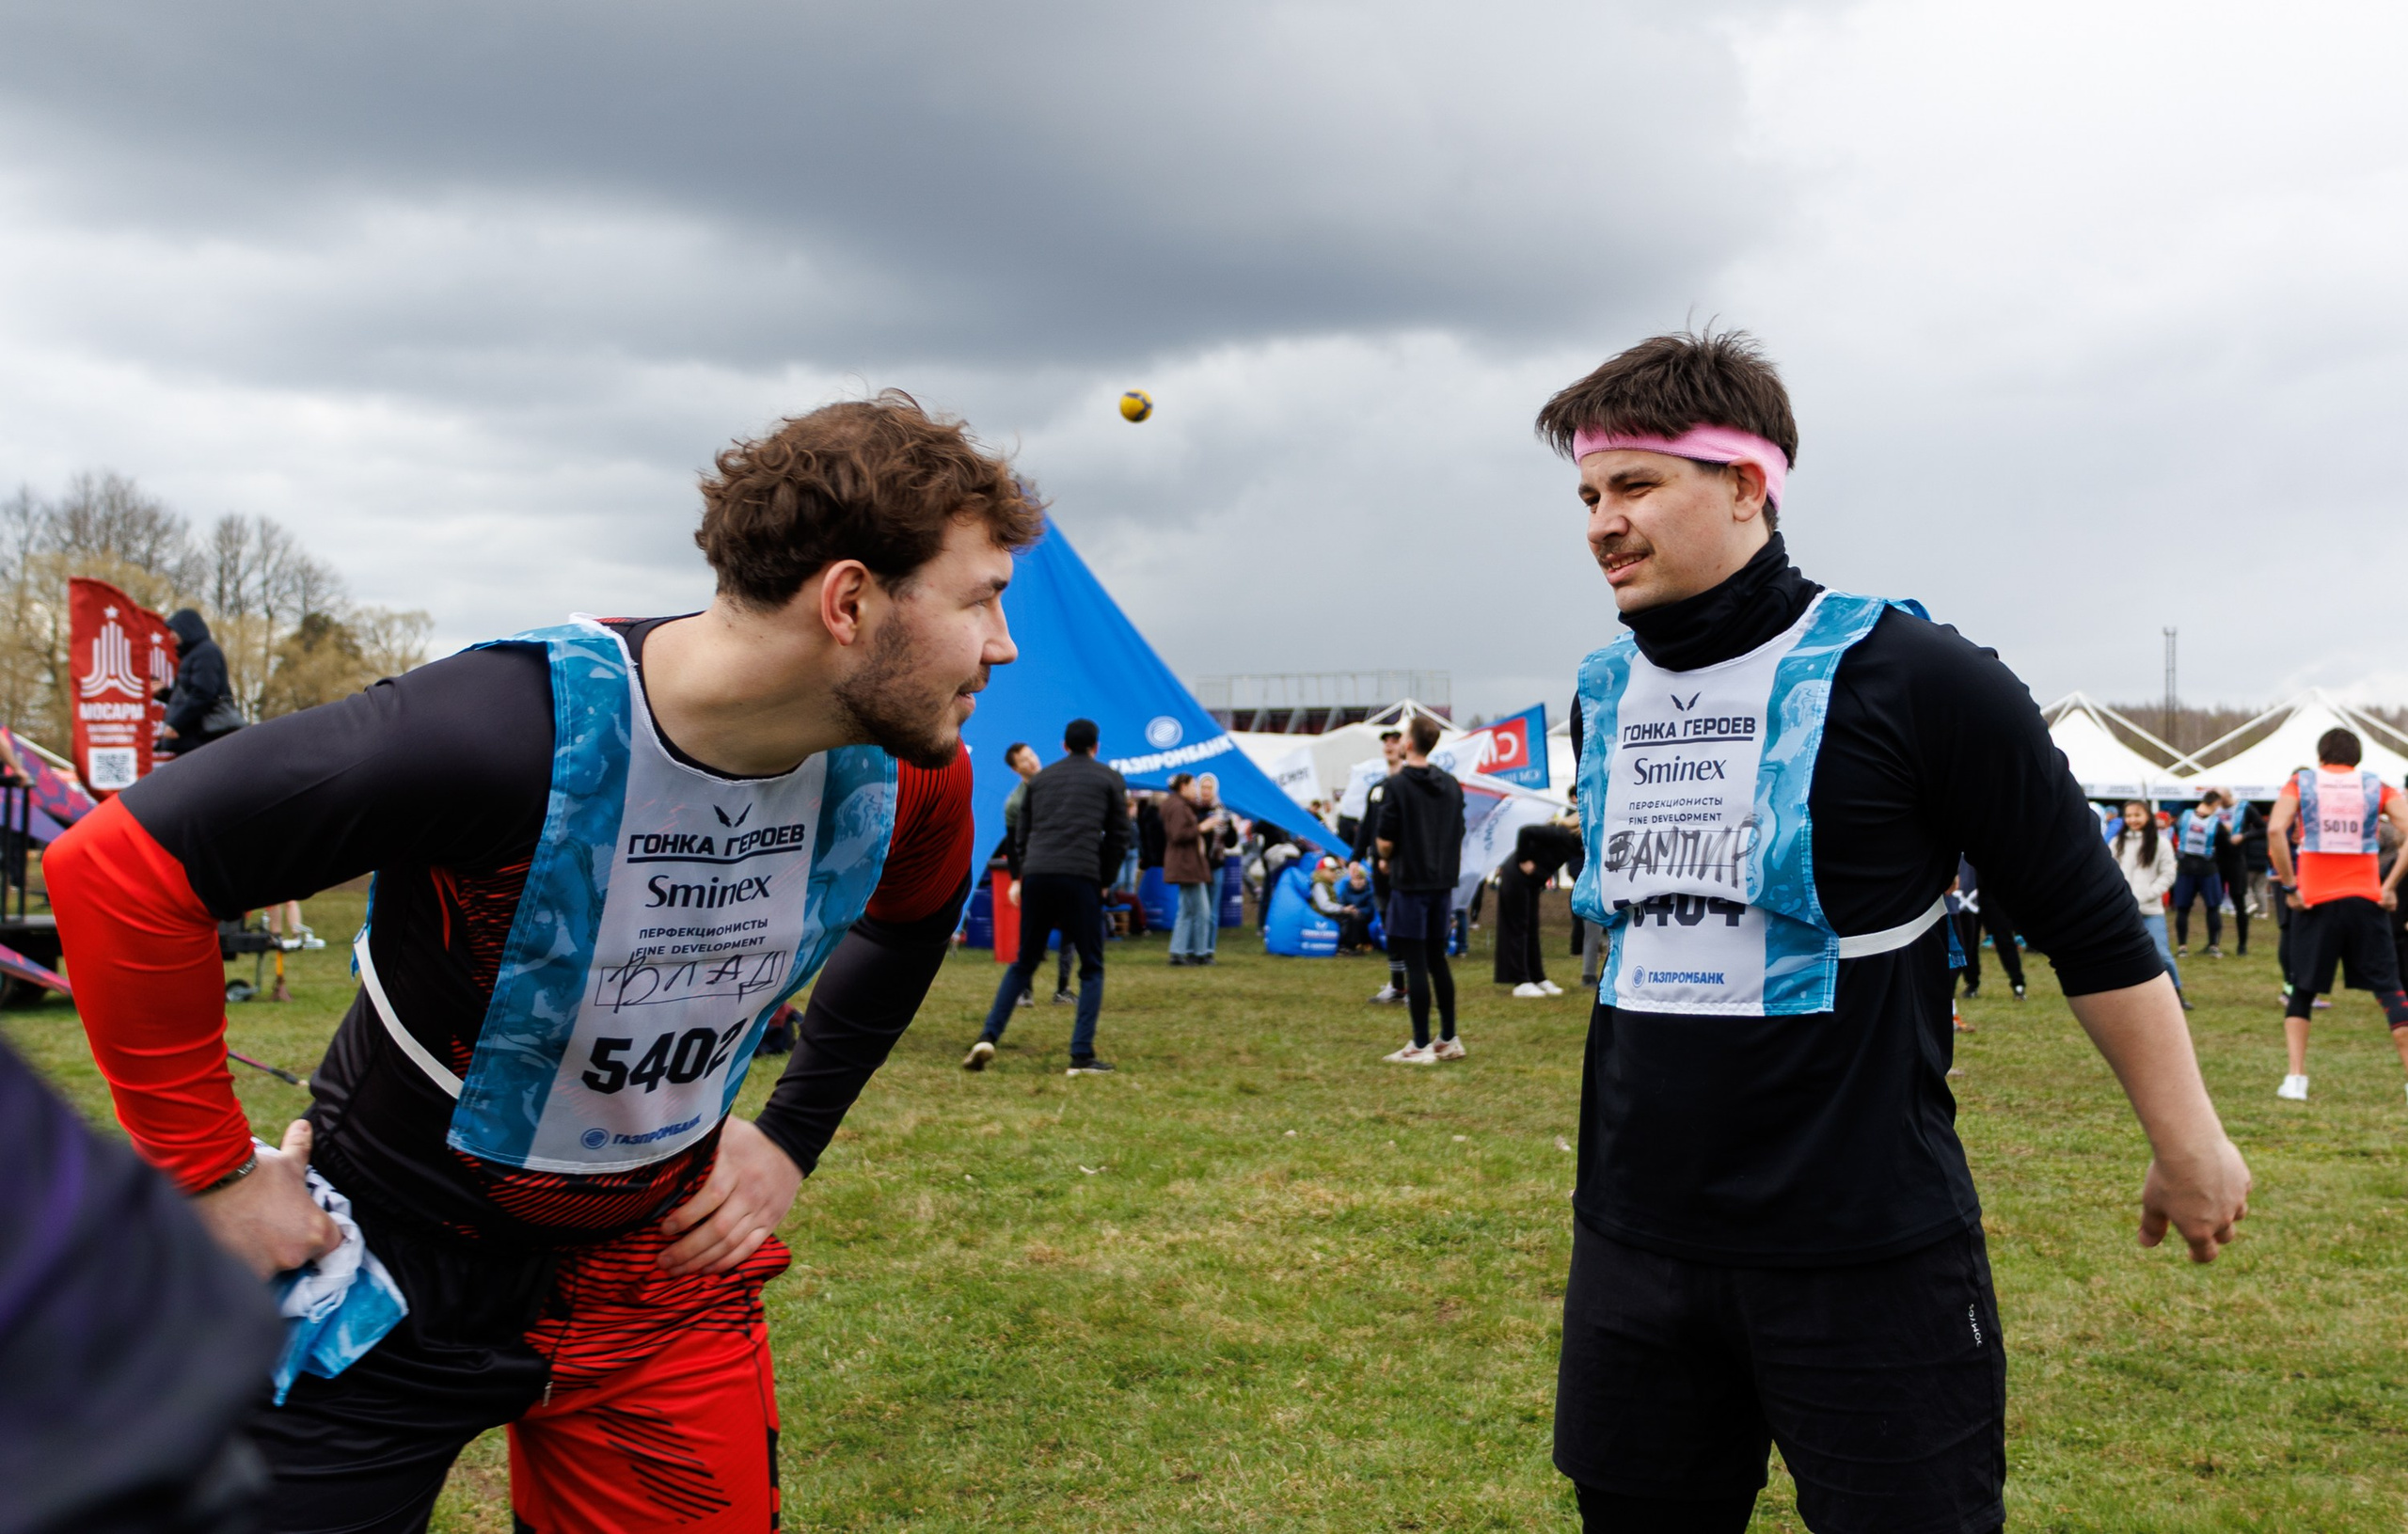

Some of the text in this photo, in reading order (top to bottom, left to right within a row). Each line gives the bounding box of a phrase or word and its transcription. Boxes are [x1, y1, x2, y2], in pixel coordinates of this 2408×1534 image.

[1623, 717, 1755, 743] ГОНКА ГЕРОЕВ
[1633, 755, 1727, 785] Sminex
[1628, 797, 1723, 811] ПЕРФЕКЦИОНИСТЫ
[1628, 813, 1722, 825] FINE DEVELOPMENT
[2323, 819, 2358, 833] 5010
[627, 824, 805, 857] ГОНКА ГЕРОЕВ
[644, 875, 772, 909] Sminex
[639, 918, 768, 940] ПЕРФЕКЦИОНИСТЫ
[636, 936, 767, 957] FINE DEVELOPMENT
[609, 950, 779, 1013] ВЛАД
[1647, 970, 1725, 985] ГАЗПРОМБАНК
[581, 1018, 748, 1095] 5402
[613, 1113, 704, 1145] ГАЗПРОМБАНК
